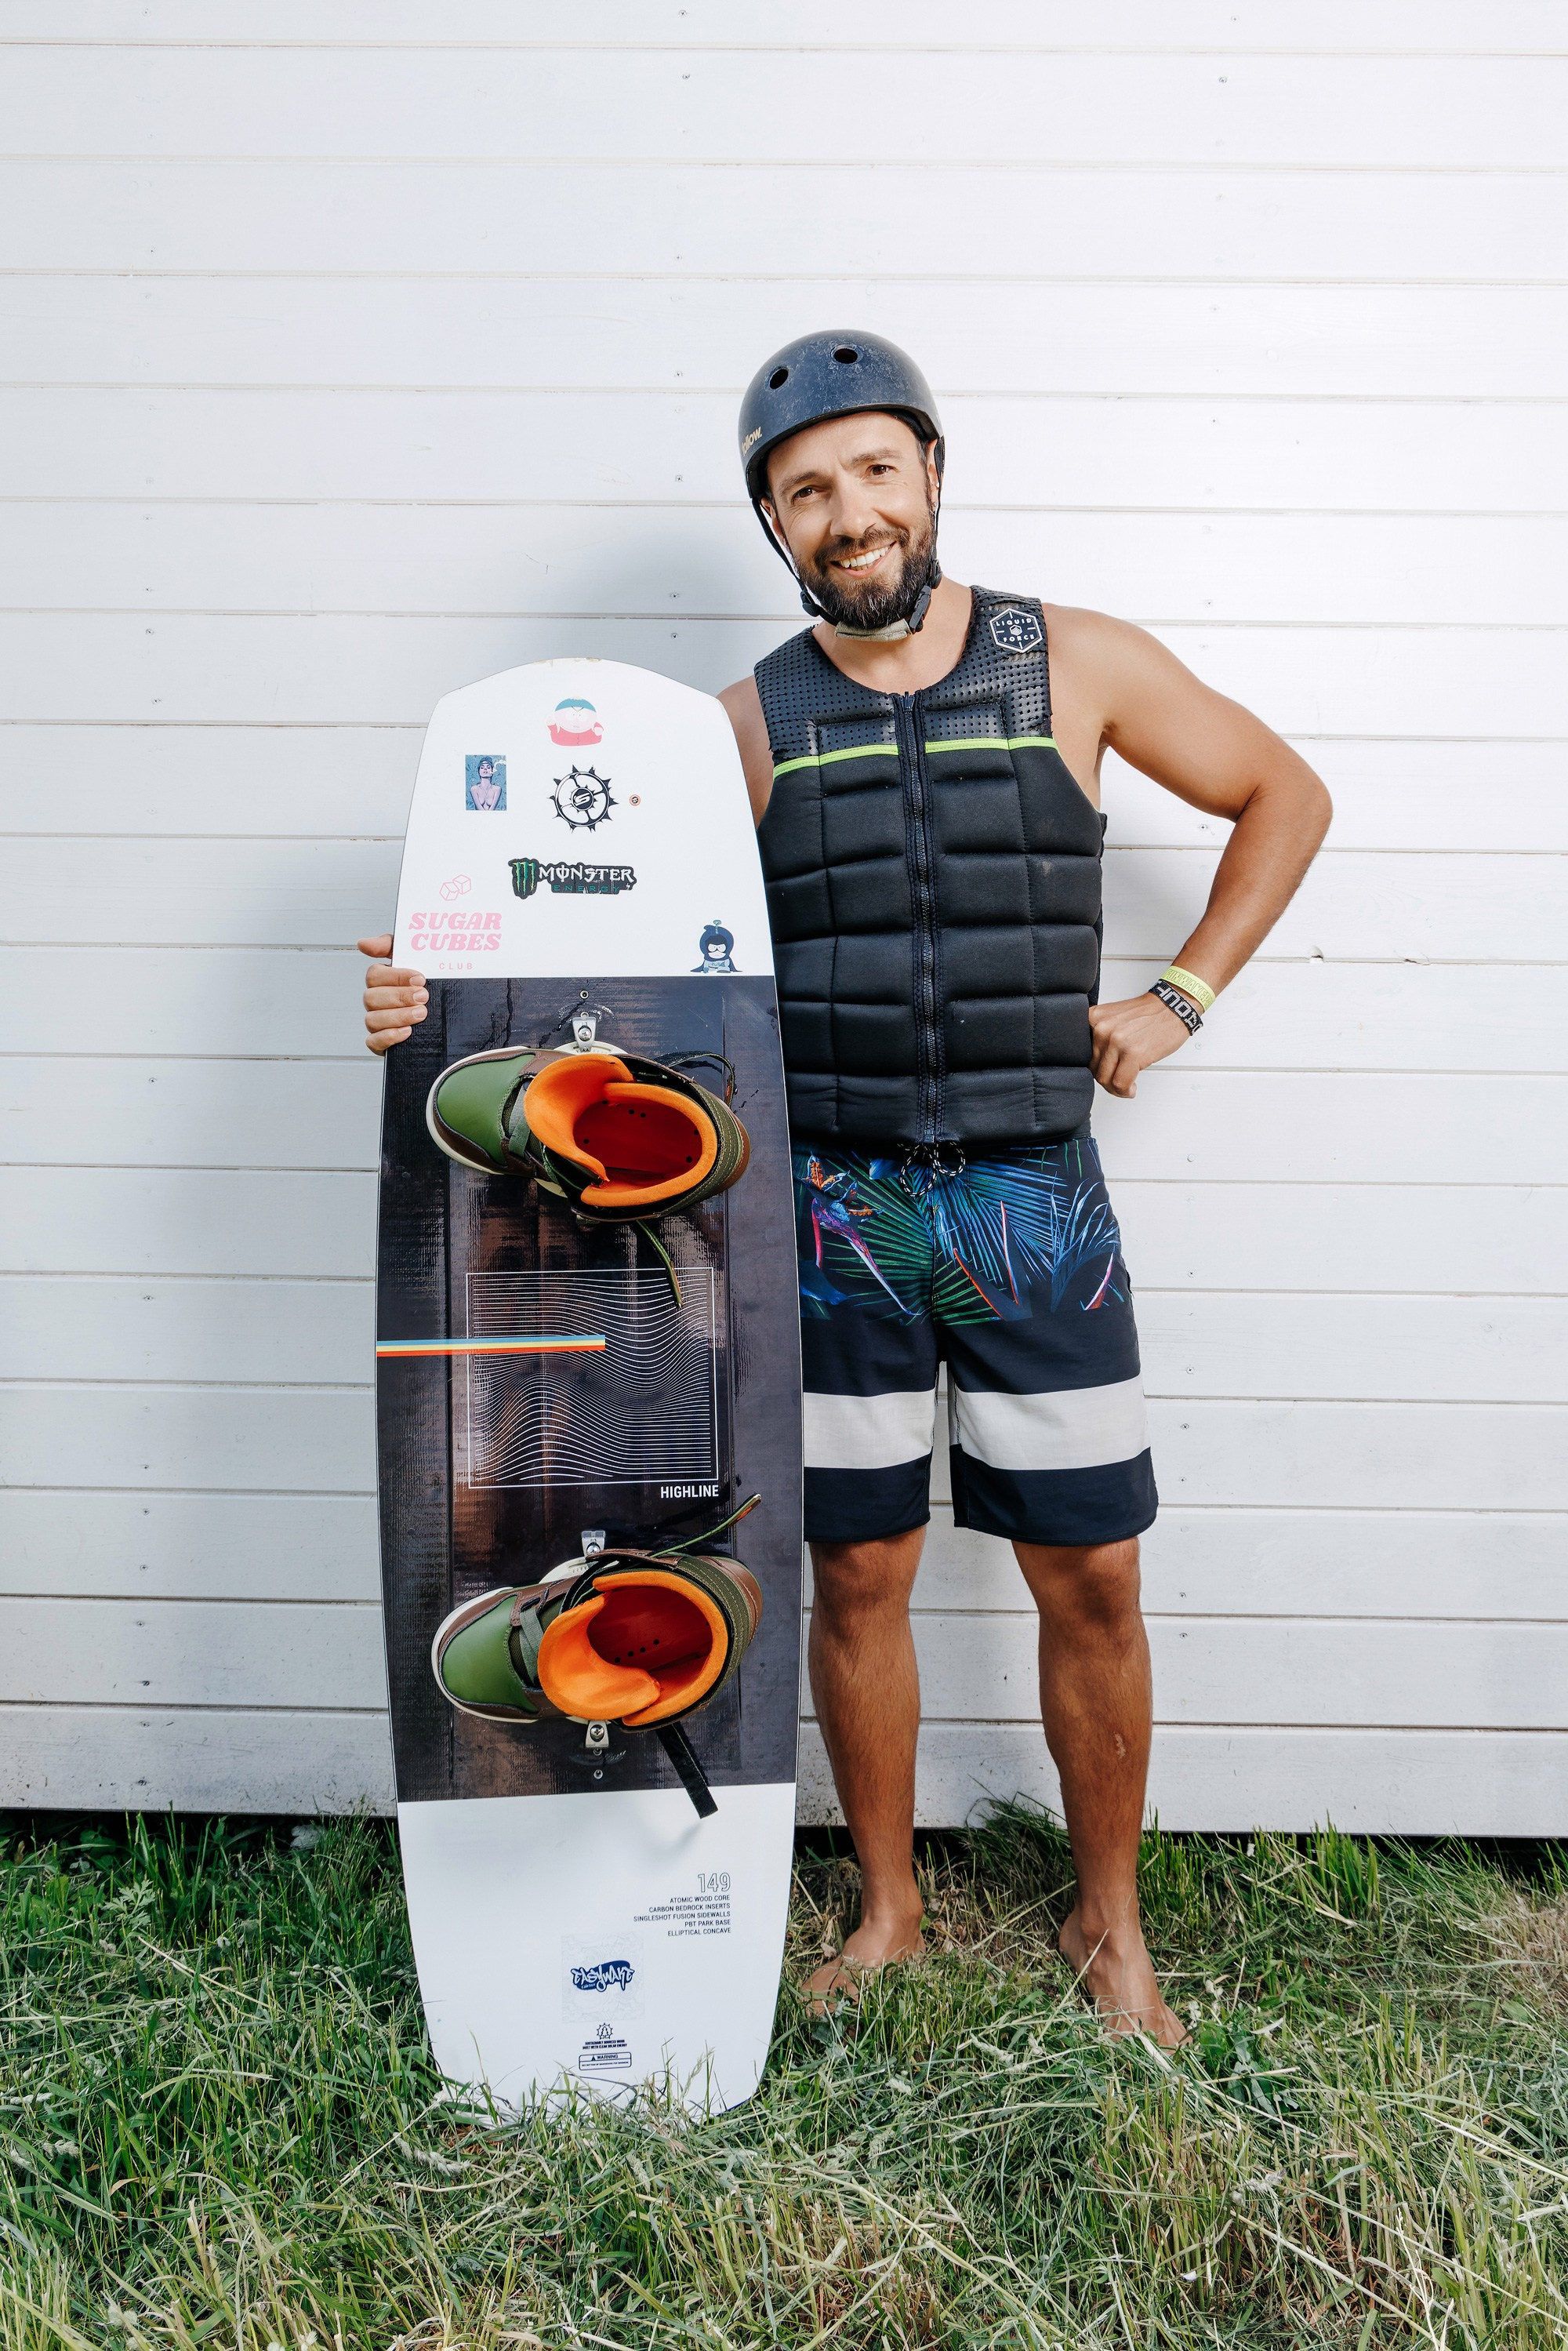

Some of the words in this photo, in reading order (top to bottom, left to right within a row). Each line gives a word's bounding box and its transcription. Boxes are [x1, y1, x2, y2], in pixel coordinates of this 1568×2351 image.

[996, 618, 1032, 627] LIQUID
[1004, 634, 1035, 643] FORCE
[539, 864, 634, 883] MONSTER
[408, 912, 503, 930] SUGAR
[411, 932, 503, 951] CUBES
[660, 1484, 720, 1499] HIGHLINE
[697, 1872, 731, 1893] 149
[633, 1913, 672, 1922] SINGLESHOT
